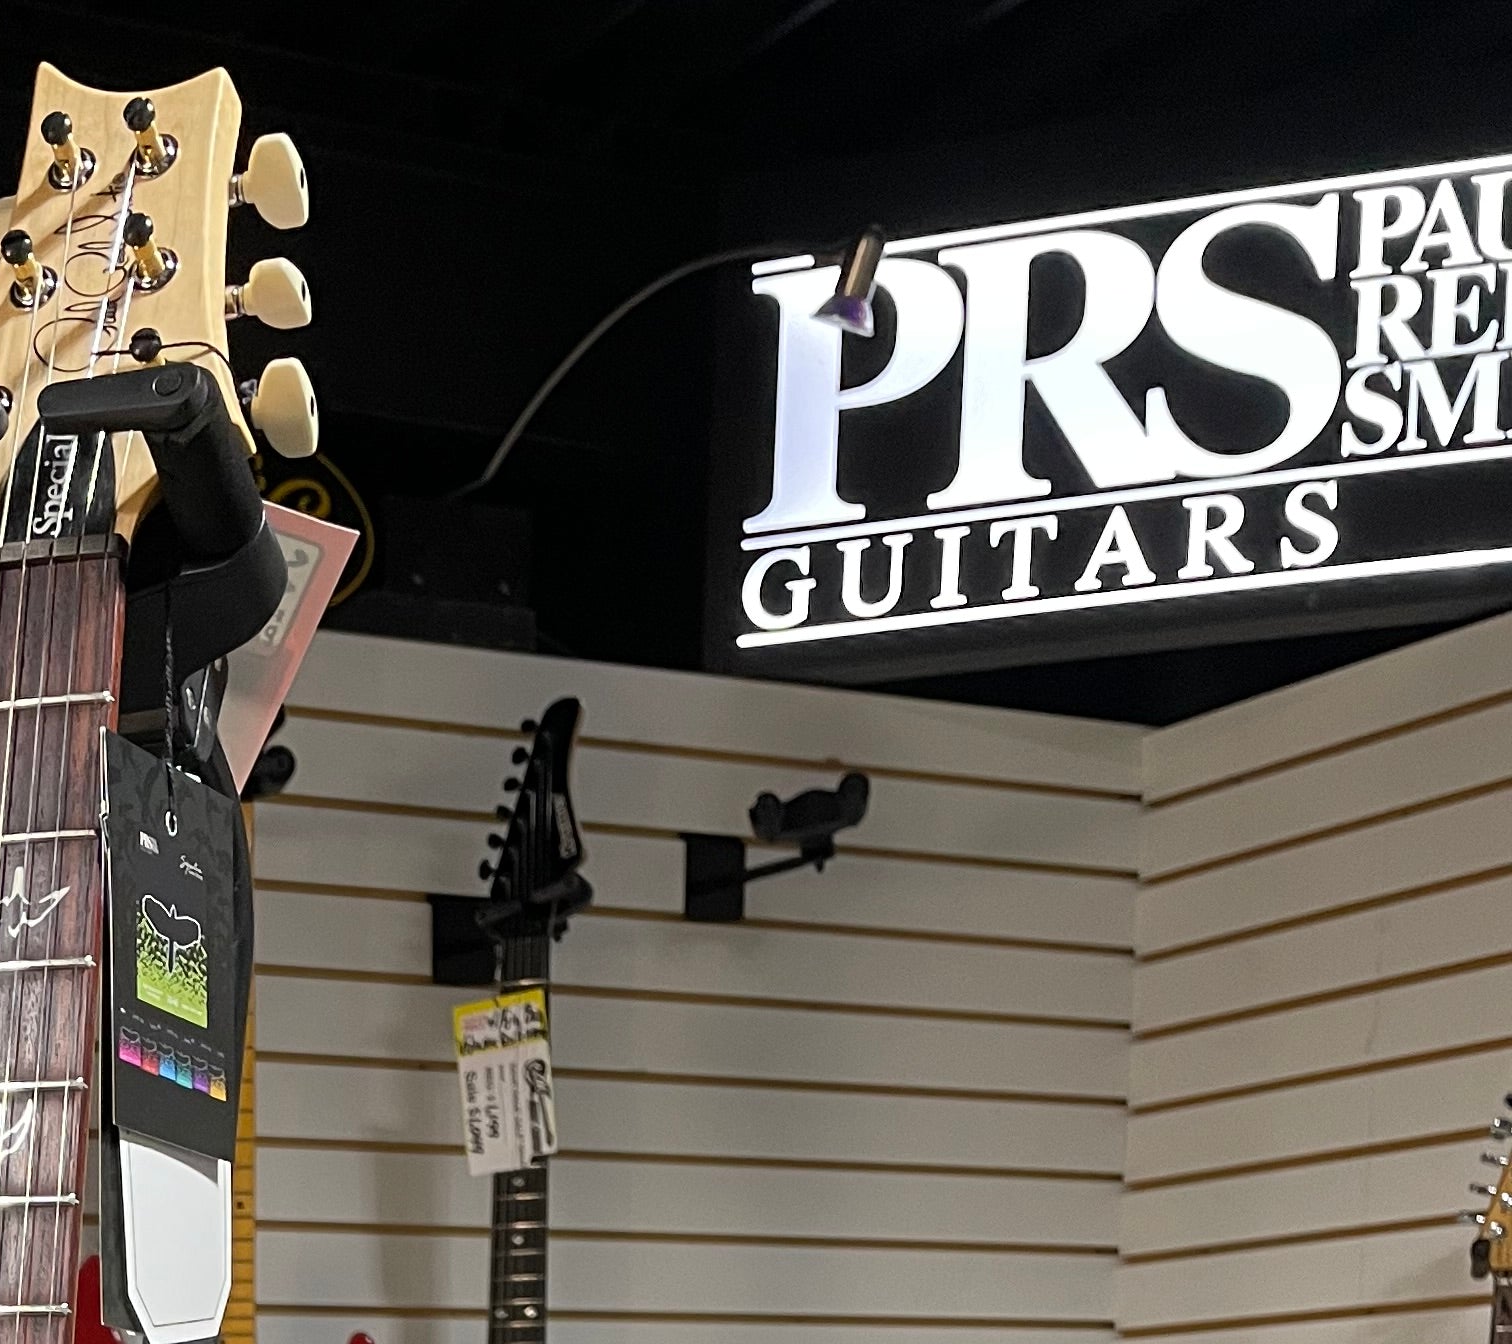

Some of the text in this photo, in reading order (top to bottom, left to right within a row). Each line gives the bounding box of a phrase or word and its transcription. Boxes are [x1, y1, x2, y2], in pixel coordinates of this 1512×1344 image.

[742, 192, 1341, 533] PRS
[1346, 261, 1512, 368] RE
[1341, 352, 1512, 458] SM
[32, 434, 78, 537] Special
[741, 480, 1340, 631] GUITARS
